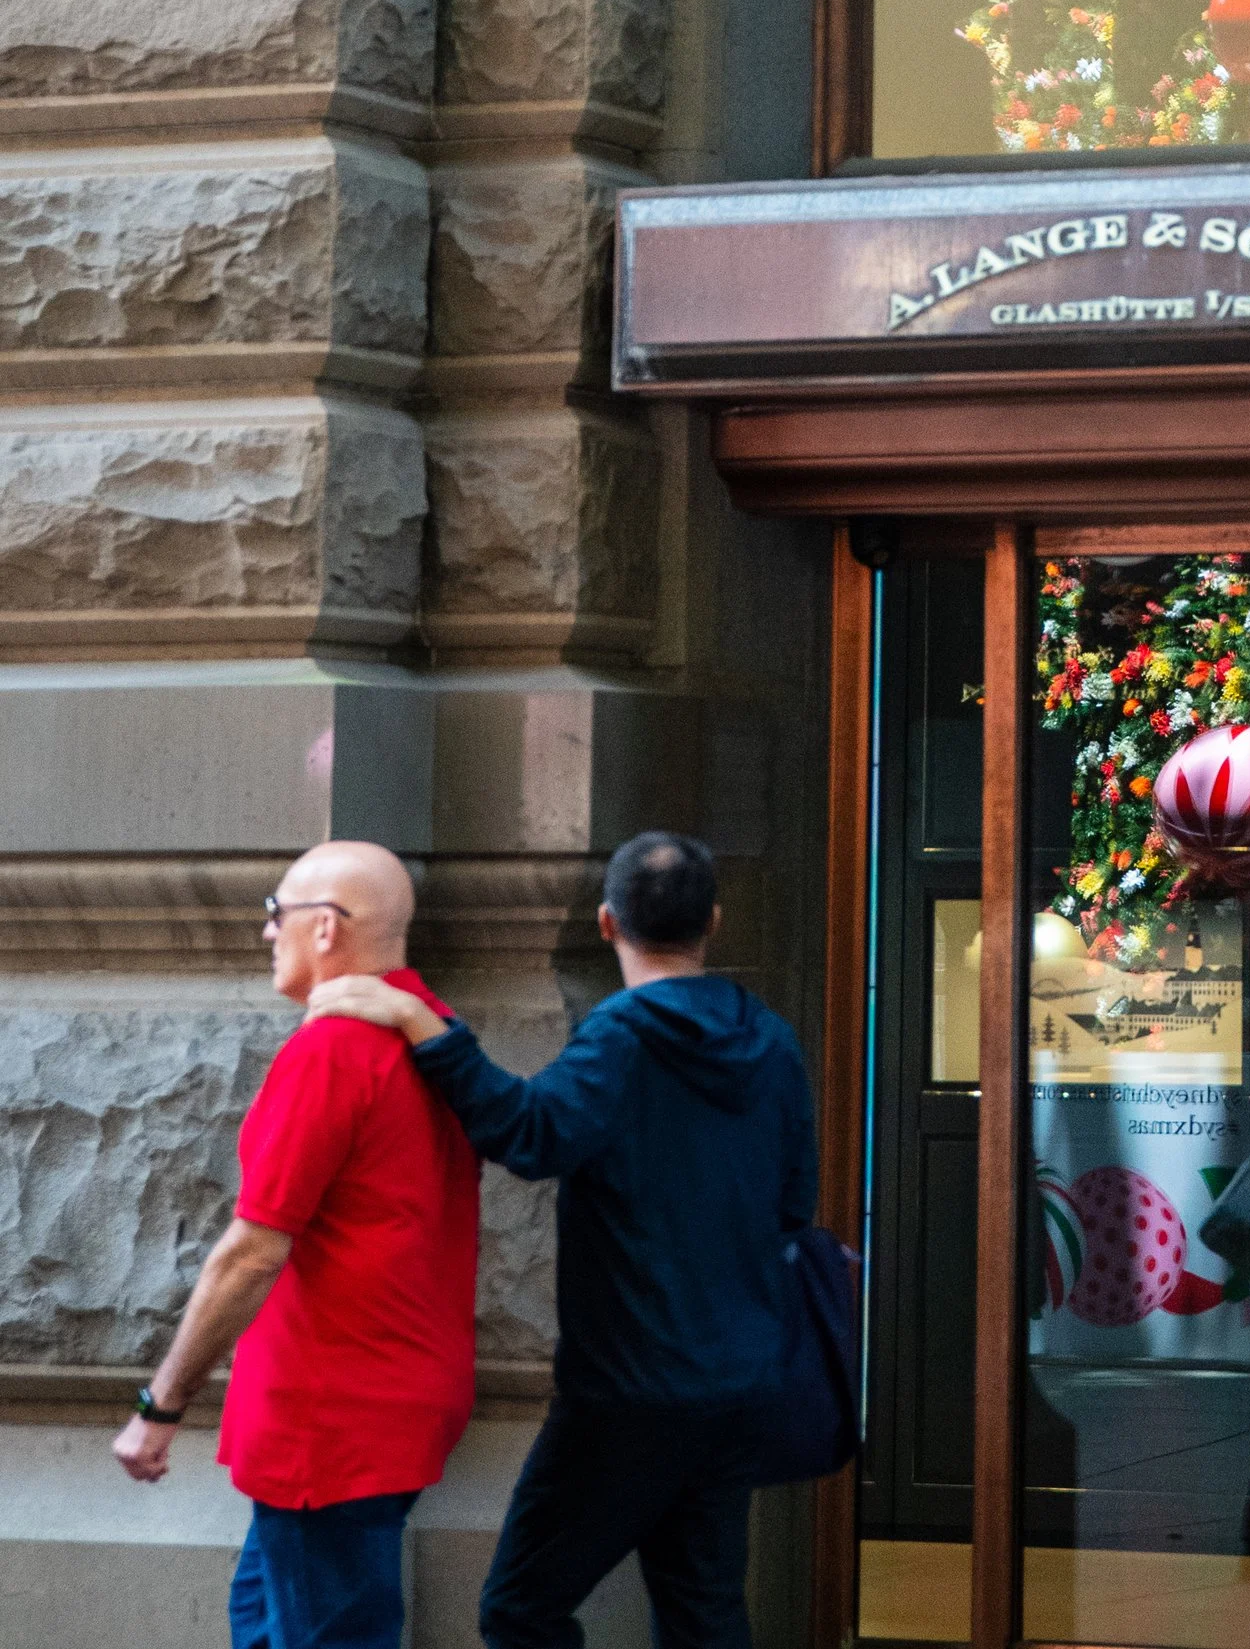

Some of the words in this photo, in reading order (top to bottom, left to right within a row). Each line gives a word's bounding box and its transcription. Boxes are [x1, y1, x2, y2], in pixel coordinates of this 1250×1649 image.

[930, 214, 1128, 297] LANGE
[1143, 212, 1186, 247] &
[990, 296, 1195, 325] GLASHÜTTE
